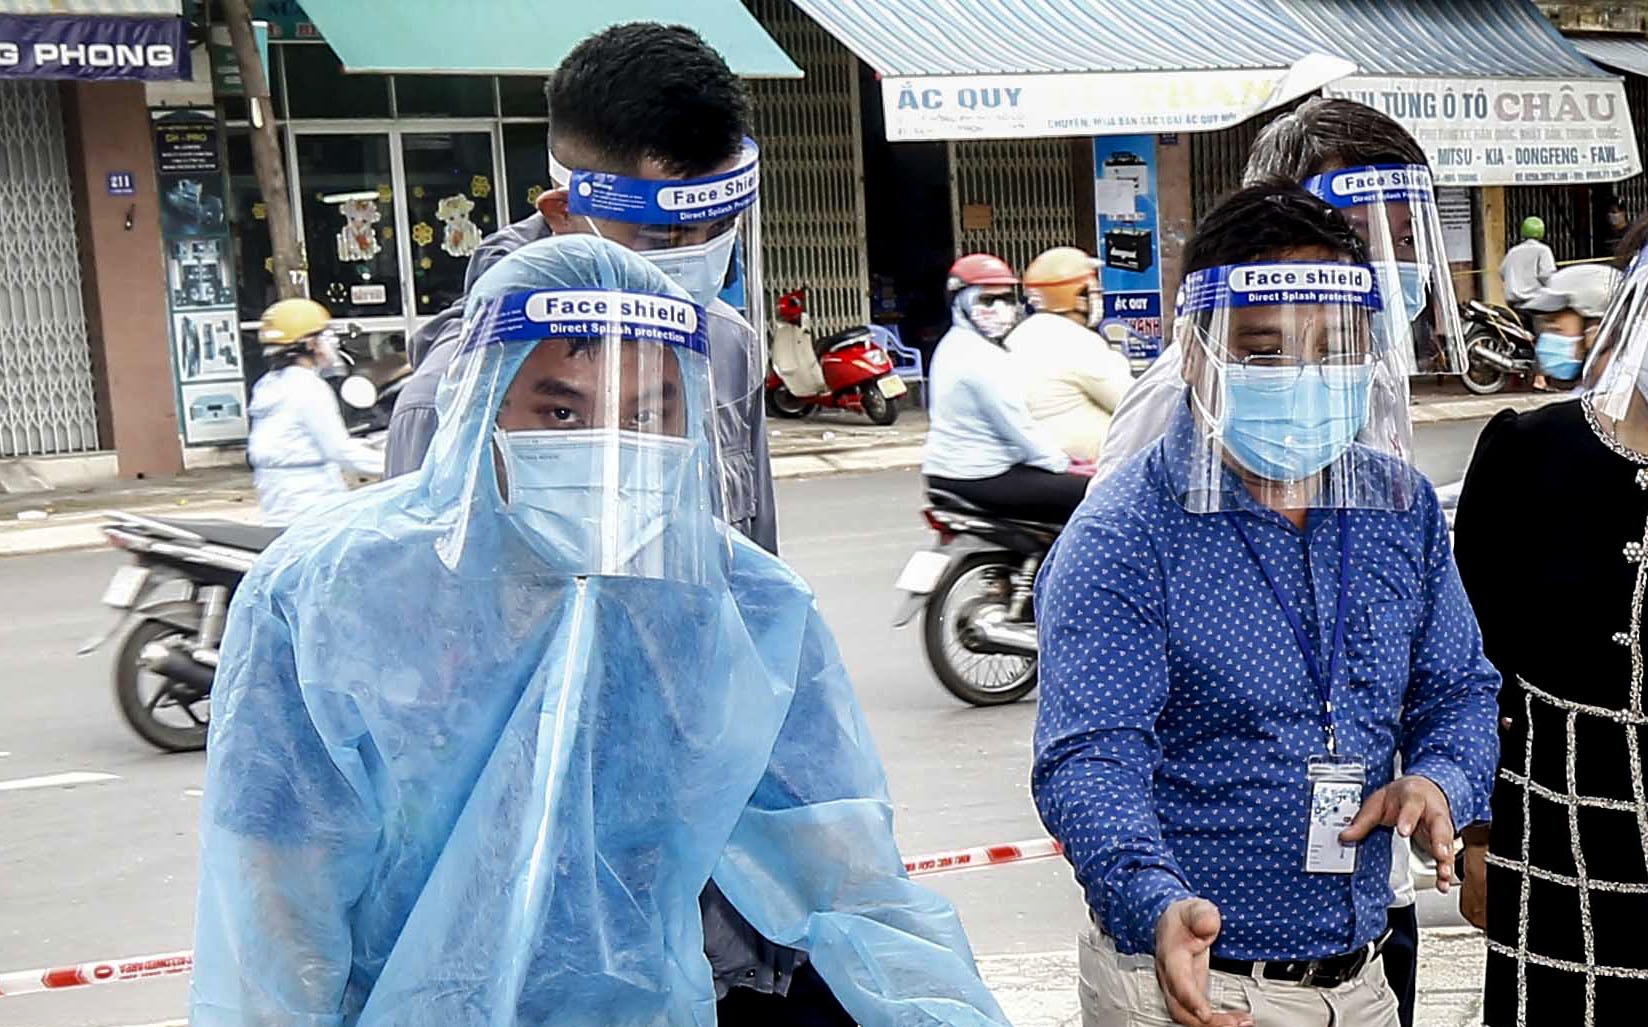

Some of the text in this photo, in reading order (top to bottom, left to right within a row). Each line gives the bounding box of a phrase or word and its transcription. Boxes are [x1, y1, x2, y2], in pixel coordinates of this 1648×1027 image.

[33, 43, 174, 67] PHONG
[957, 87, 1022, 111] QUY
[1381, 86, 1437, 119] TÙNG
[1443, 87, 1457, 119] Ô
[1463, 87, 1488, 119] TÔ
[1492, 84, 1617, 122] CHÂU
[1437, 147, 1473, 166] MITSU
[1485, 148, 1505, 166] KIA
[1515, 146, 1579, 166] DONGFENG
[1344, 175, 1386, 191] Face
[673, 187, 718, 206] Face
[680, 210, 706, 221] Direct
[1244, 270, 1363, 287] Face shield
[1248, 292, 1363, 303] Direct Splash protection
[545, 297, 687, 325] Face shield
[550, 323, 686, 344] Direct Splash protection
